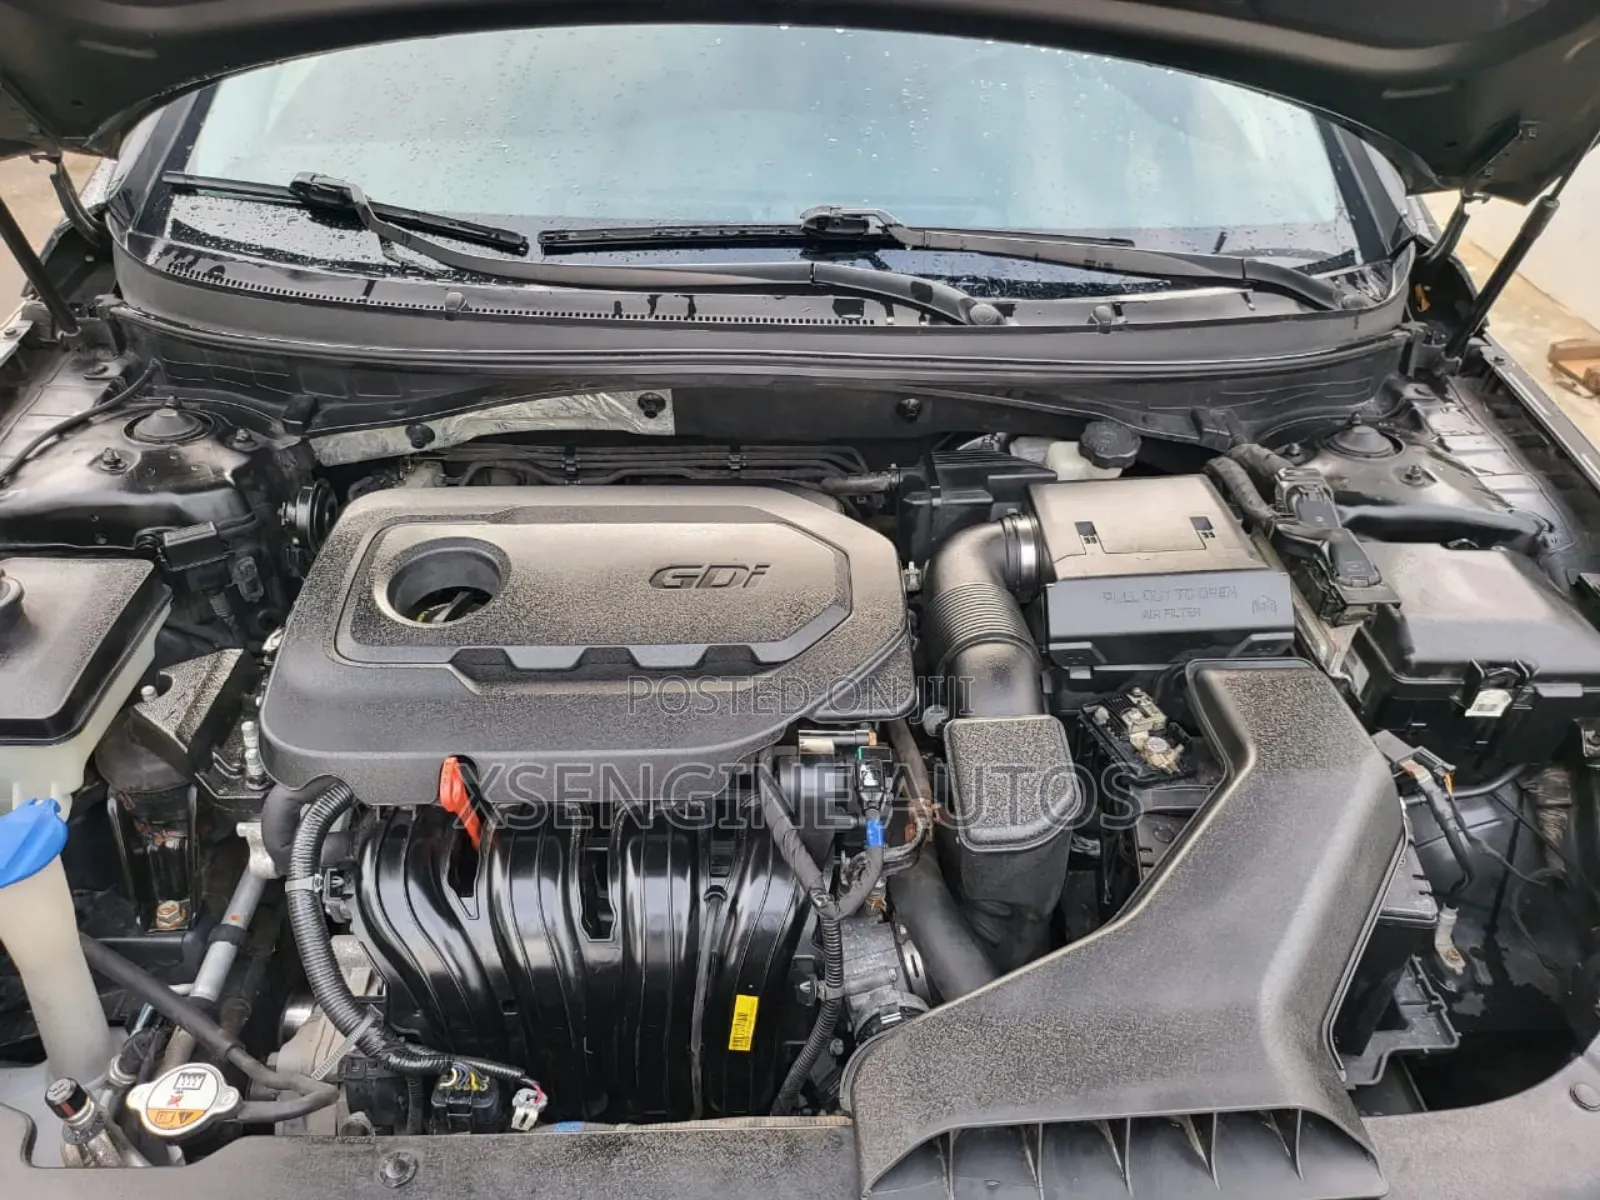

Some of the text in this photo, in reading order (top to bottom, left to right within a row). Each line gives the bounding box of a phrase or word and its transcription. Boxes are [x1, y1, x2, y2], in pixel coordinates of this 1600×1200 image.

[1143, 589, 1171, 602] OUT
[1173, 587, 1194, 600] TO
[1142, 607, 1201, 620] AIR FILTER
